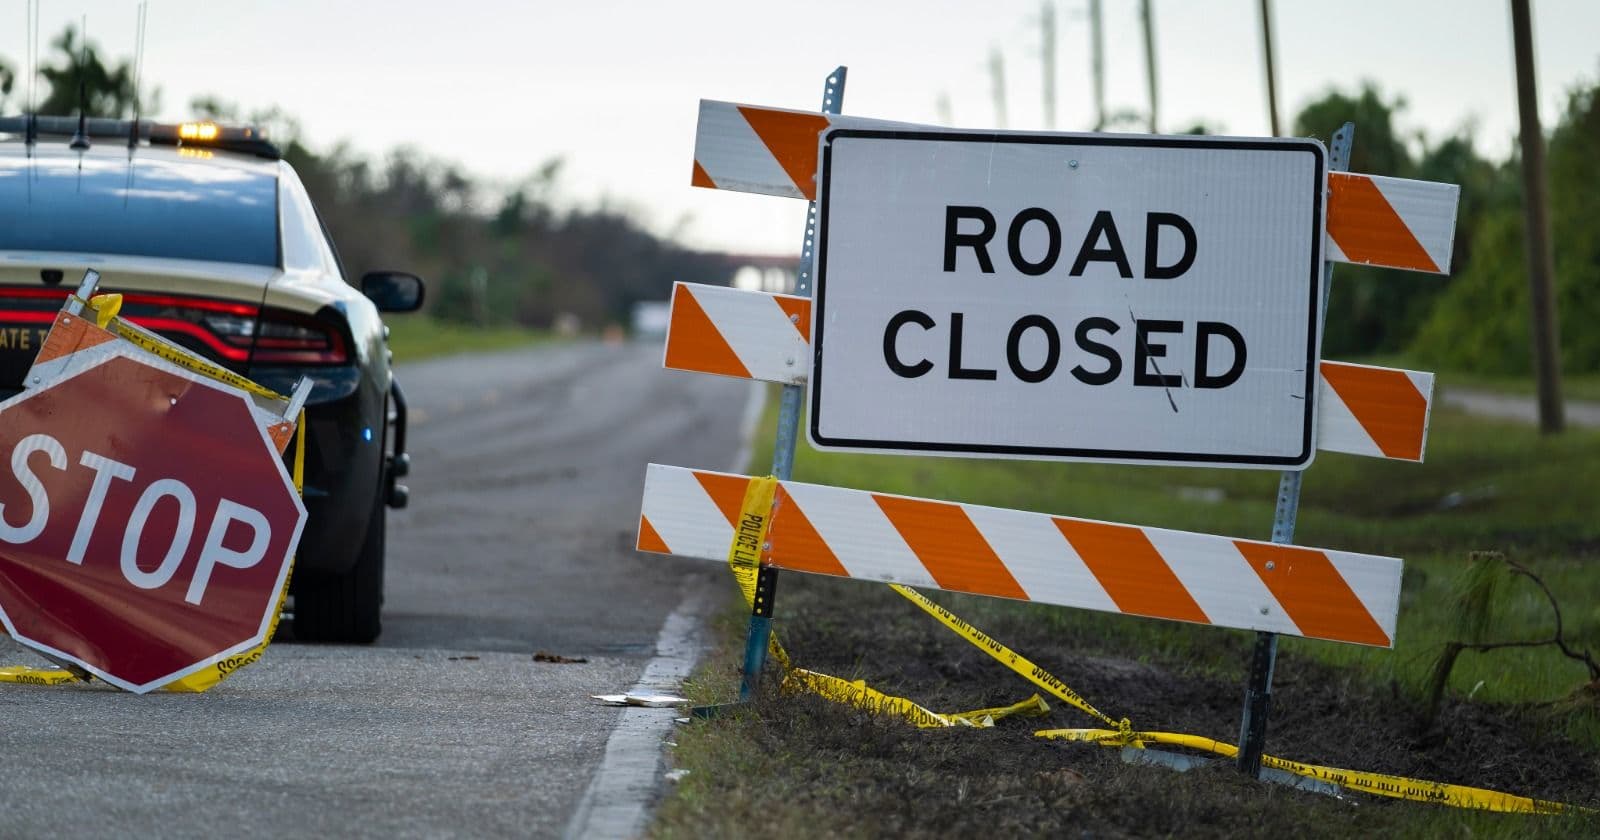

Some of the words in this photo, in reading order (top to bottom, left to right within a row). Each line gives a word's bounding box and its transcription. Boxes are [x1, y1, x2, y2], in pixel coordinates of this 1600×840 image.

[943, 205, 1197, 280] ROAD
[883, 310, 1247, 389] CLOSED
[0, 433, 272, 606] STOP
[736, 513, 763, 551] POLICE
